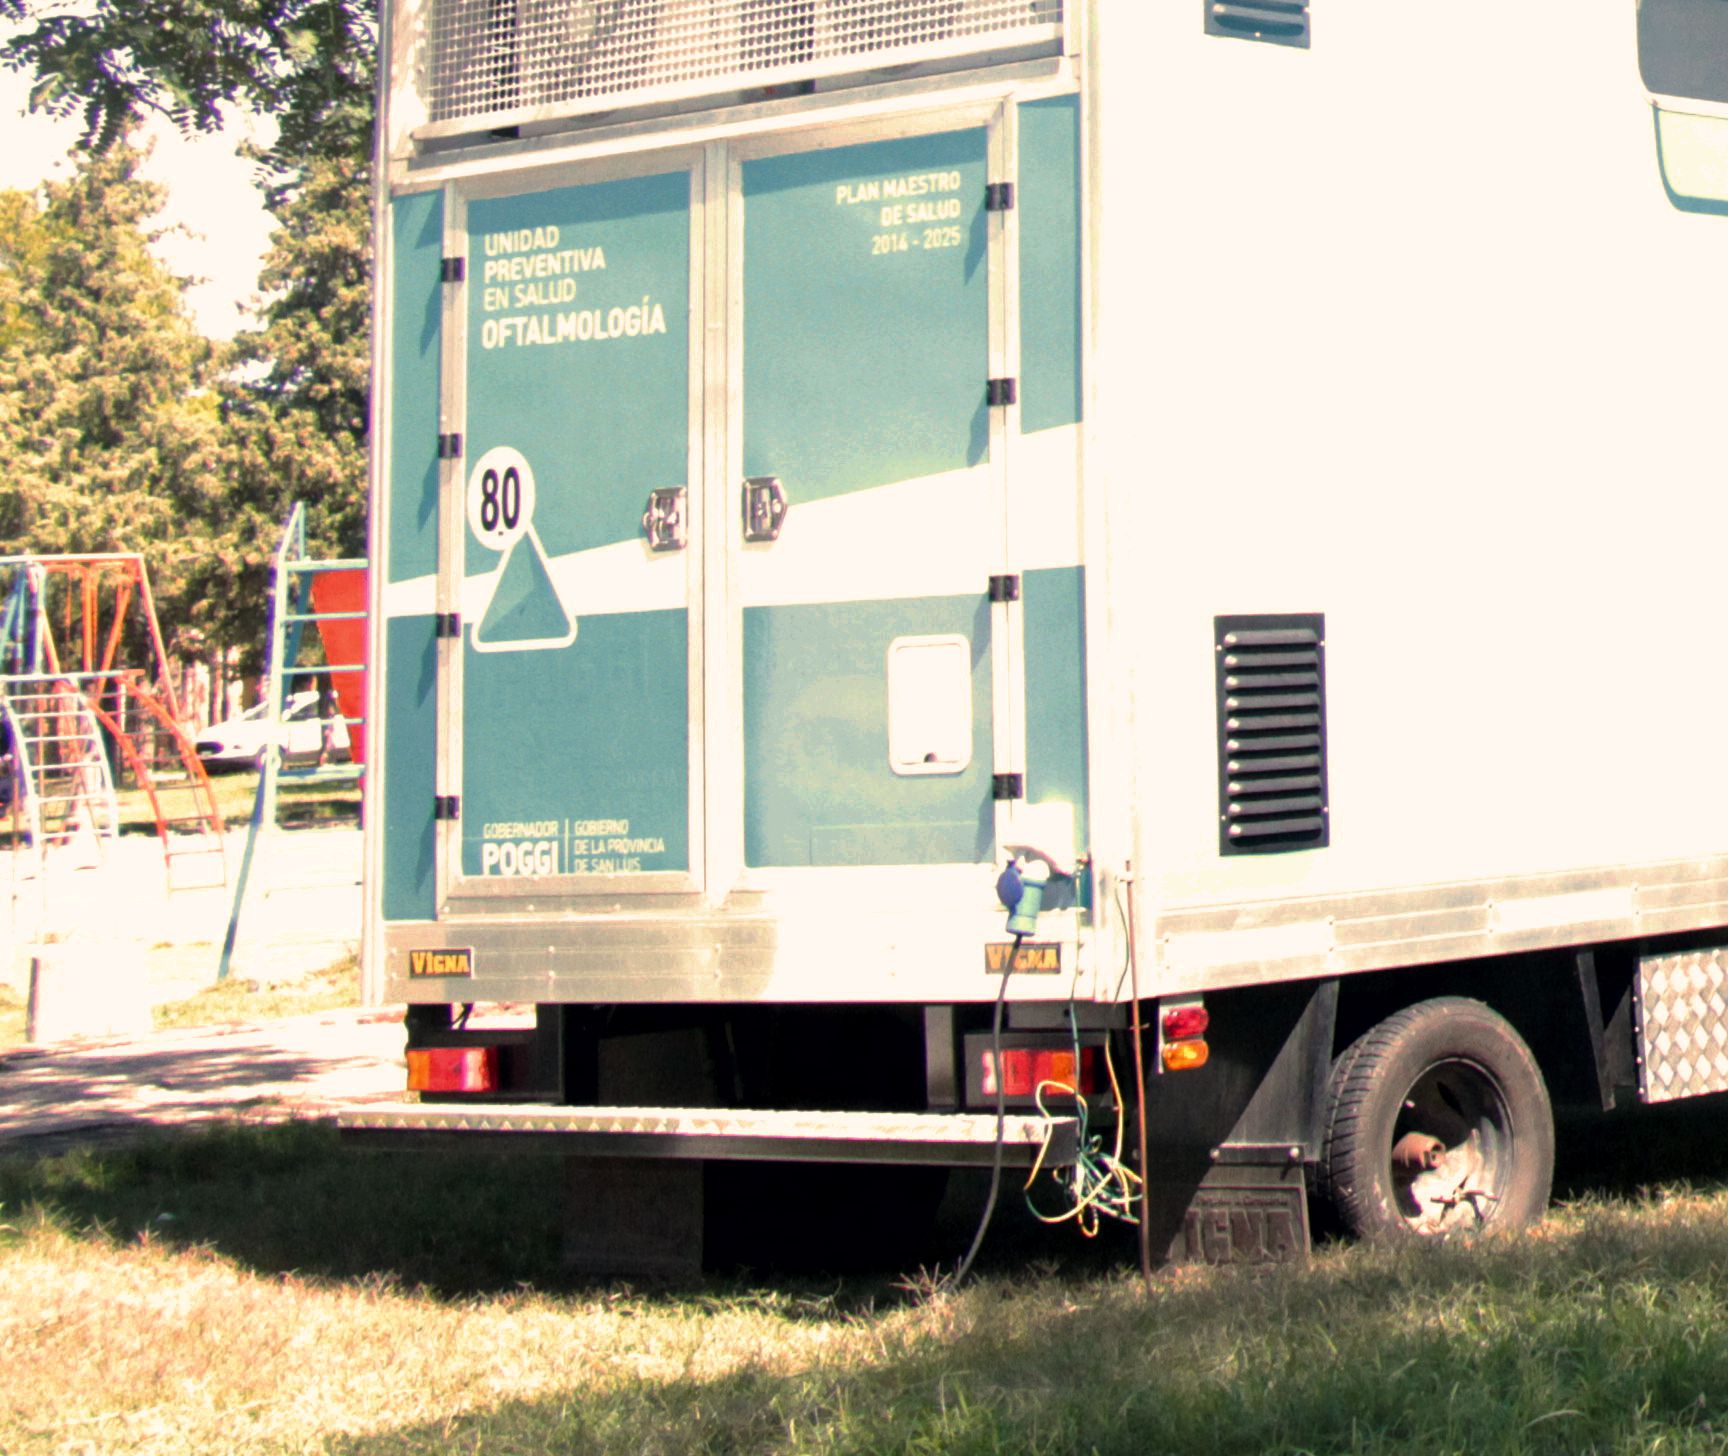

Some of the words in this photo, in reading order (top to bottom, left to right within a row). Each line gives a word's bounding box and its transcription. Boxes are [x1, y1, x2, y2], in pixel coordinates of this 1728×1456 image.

[836, 181, 880, 205] PLAN
[883, 171, 960, 198] MAESTRO
[881, 205, 903, 227] DE
[906, 199, 961, 224] SALUD
[484, 225, 560, 257] UNIDAD
[871, 233, 908, 255] 2014
[923, 226, 961, 250] 2025
[484, 246, 606, 284] PREVENTIVA
[483, 287, 509, 312] EN
[514, 278, 577, 308] SALUD
[481, 295, 667, 350] OFTALMOLOGÍA
[481, 466, 521, 531] 80
[483, 820, 560, 839] GOBERNADOR
[574, 819, 630, 836] GOBIERNO
[482, 840, 560, 876] POGGI
[574, 839, 590, 855] DE
[592, 839, 606, 854] LA
[607, 836, 665, 853] PROVINCIA
[574, 858, 588, 873] DE
[591, 858, 614, 873] SAN
[616, 856, 641, 873] LUIS
[411, 951, 470, 975] VIGNA
[1185, 1206, 1299, 1266] IGNA
